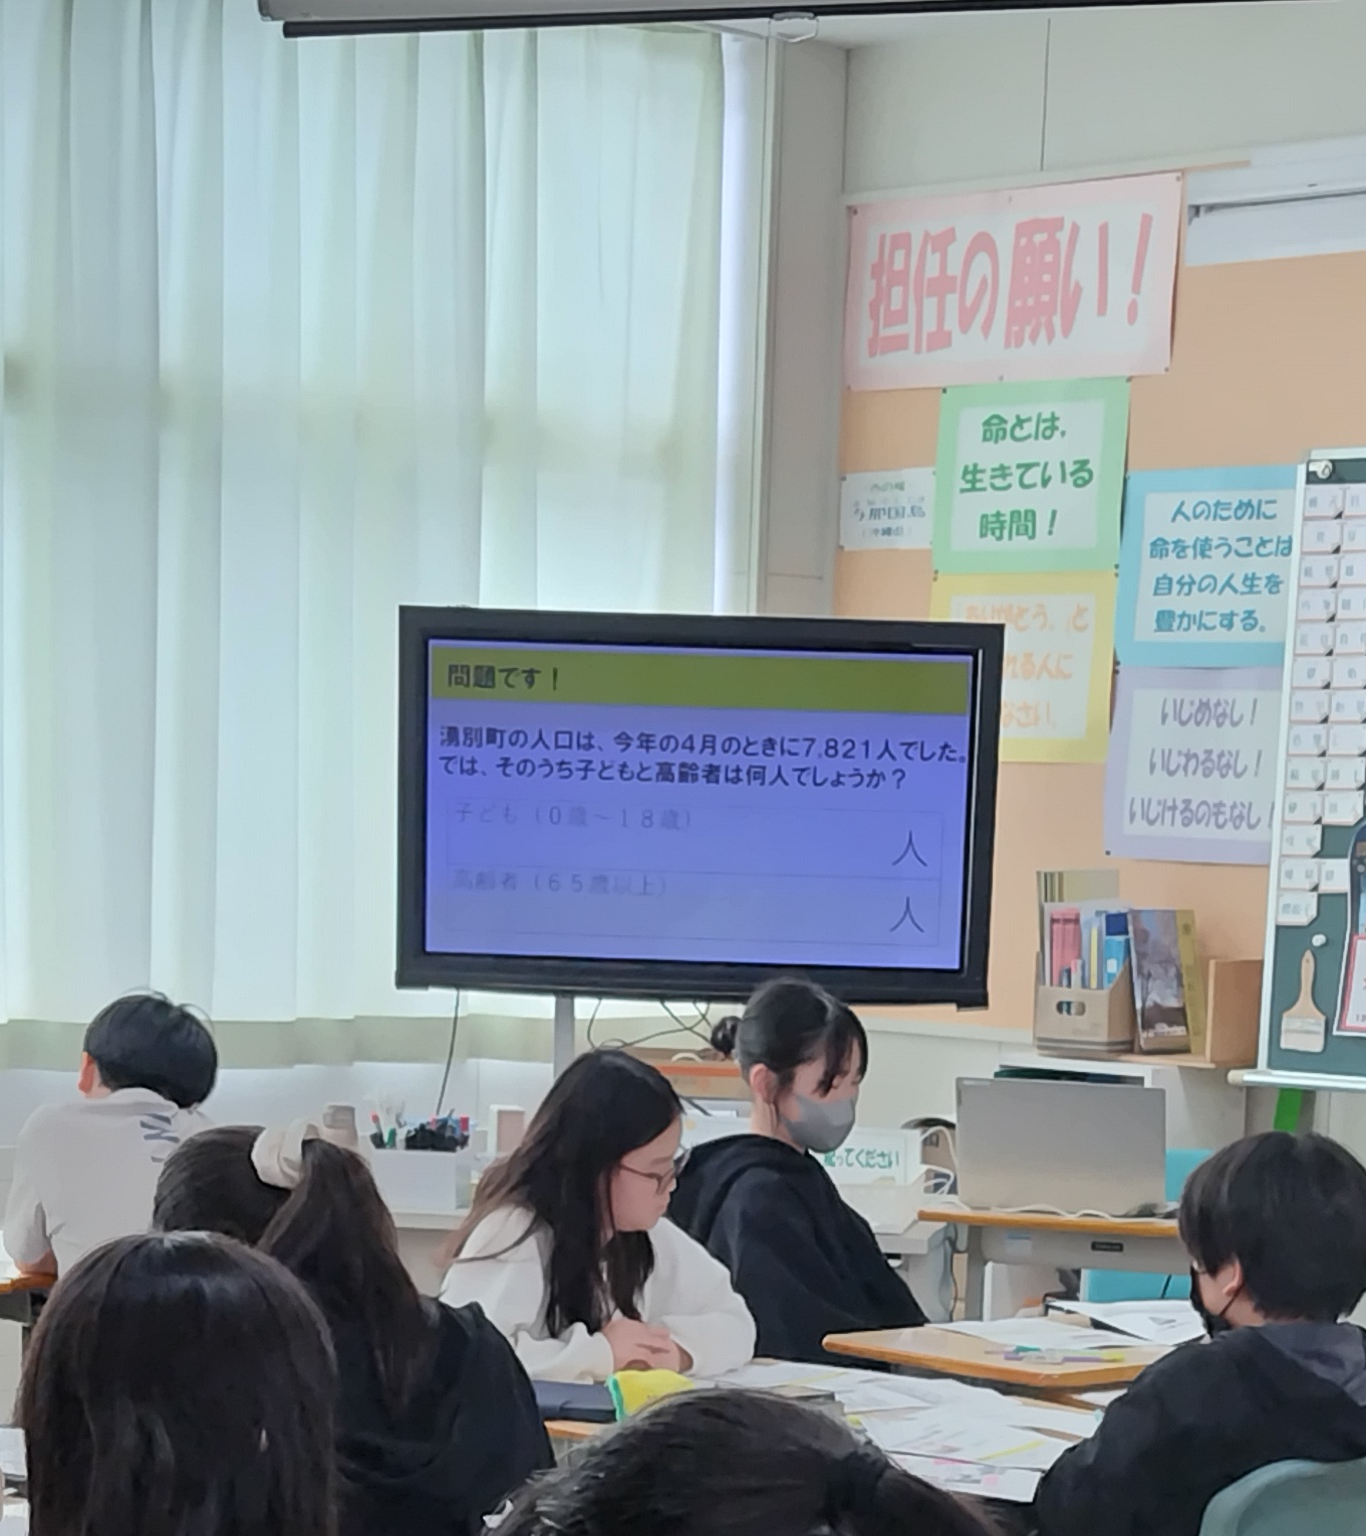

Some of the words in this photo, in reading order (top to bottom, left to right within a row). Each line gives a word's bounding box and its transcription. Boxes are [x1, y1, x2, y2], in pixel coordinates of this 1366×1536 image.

[867, 211, 1154, 358] 担任の願い!
[981, 412, 1066, 446] 命とは、
[960, 459, 1094, 495] 生きている
[978, 507, 1058, 543] 時間!
[1169, 497, 1277, 525] 人のために
[1148, 532, 1293, 562] 命を使うことは
[1151, 570, 1285, 599] 自分の人生を
[1153, 608, 1267, 635] 豊かにする。
[447, 662, 561, 692] 問題です!
[1159, 696, 1259, 727] いじめなし!
[438, 753, 906, 790] では、そのうち子どもと高齢者は何人でしょうか?
[1148, 747, 1262, 780] いじわるなし!
[891, 830, 928, 868] 人
[888, 896, 925, 934] 人
